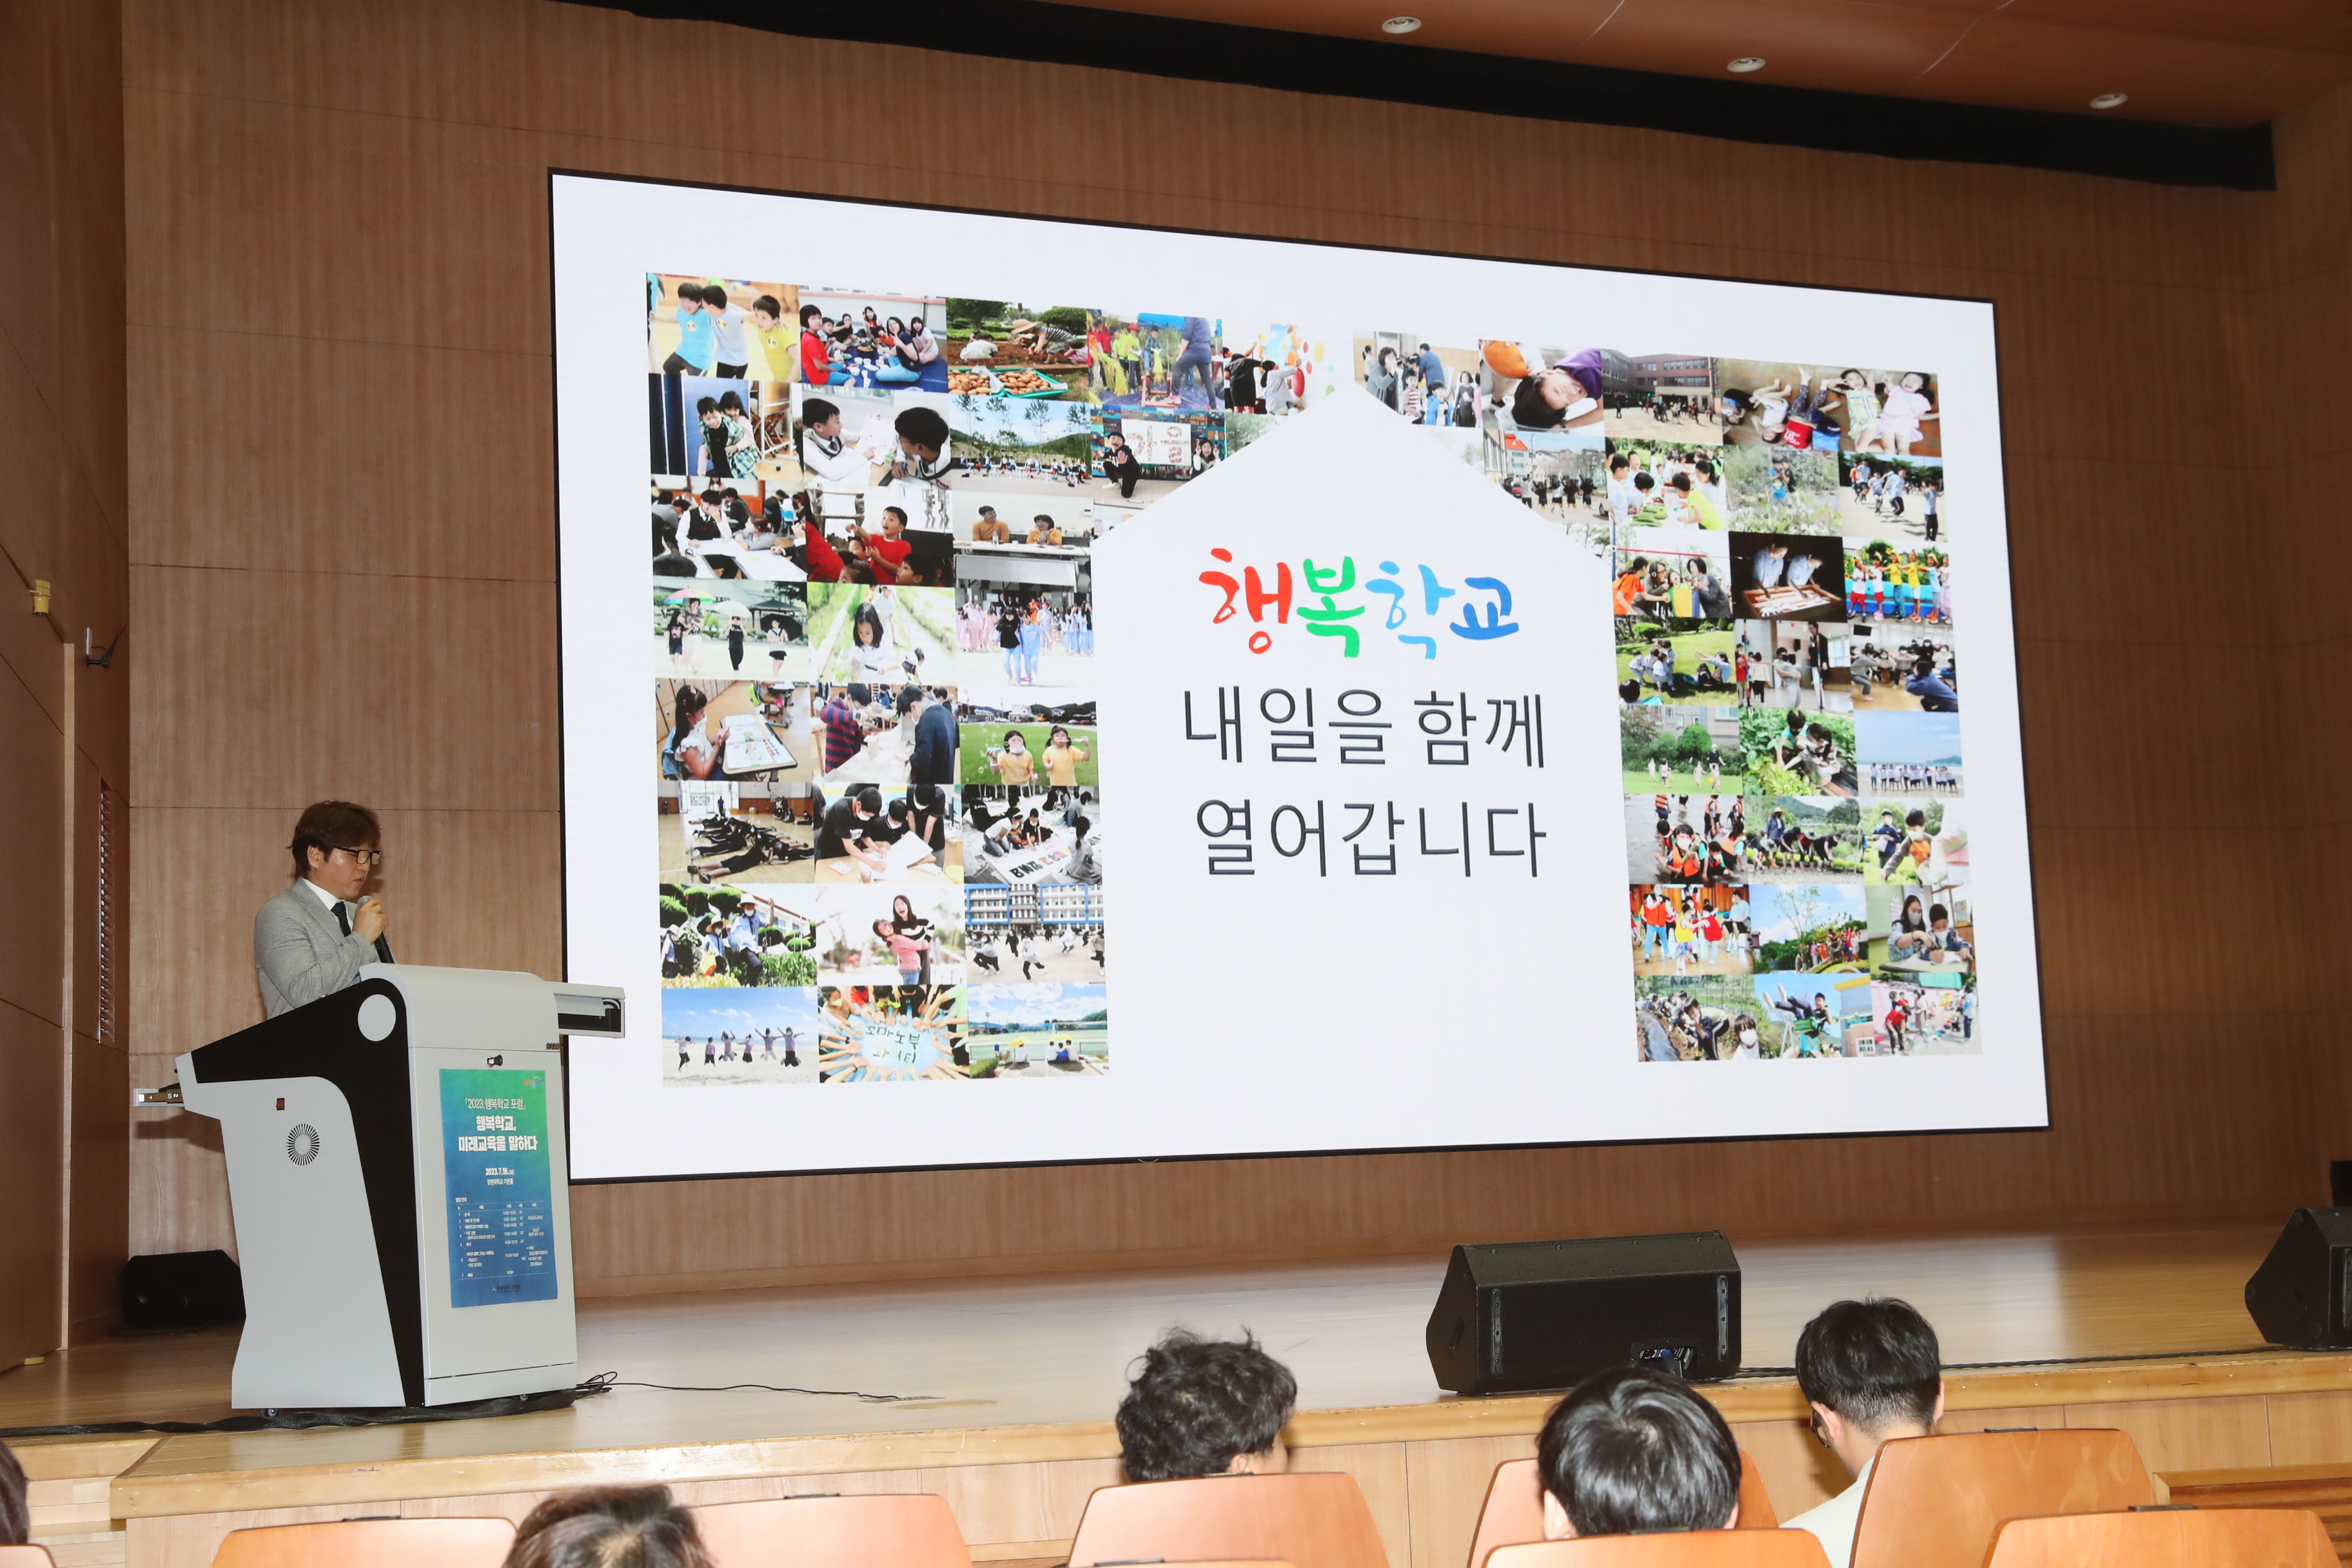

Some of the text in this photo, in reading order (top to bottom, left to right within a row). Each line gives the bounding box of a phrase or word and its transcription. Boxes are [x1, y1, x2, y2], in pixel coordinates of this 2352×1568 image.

[1199, 548, 1519, 660] 행복학교
[1185, 686, 1544, 769] 내일을 함께
[1197, 799, 1547, 877] 열어갑니다
[458, 1135, 538, 1152] 미래교육을 말하다
[476, 1115, 516, 1132] 행복학교,
